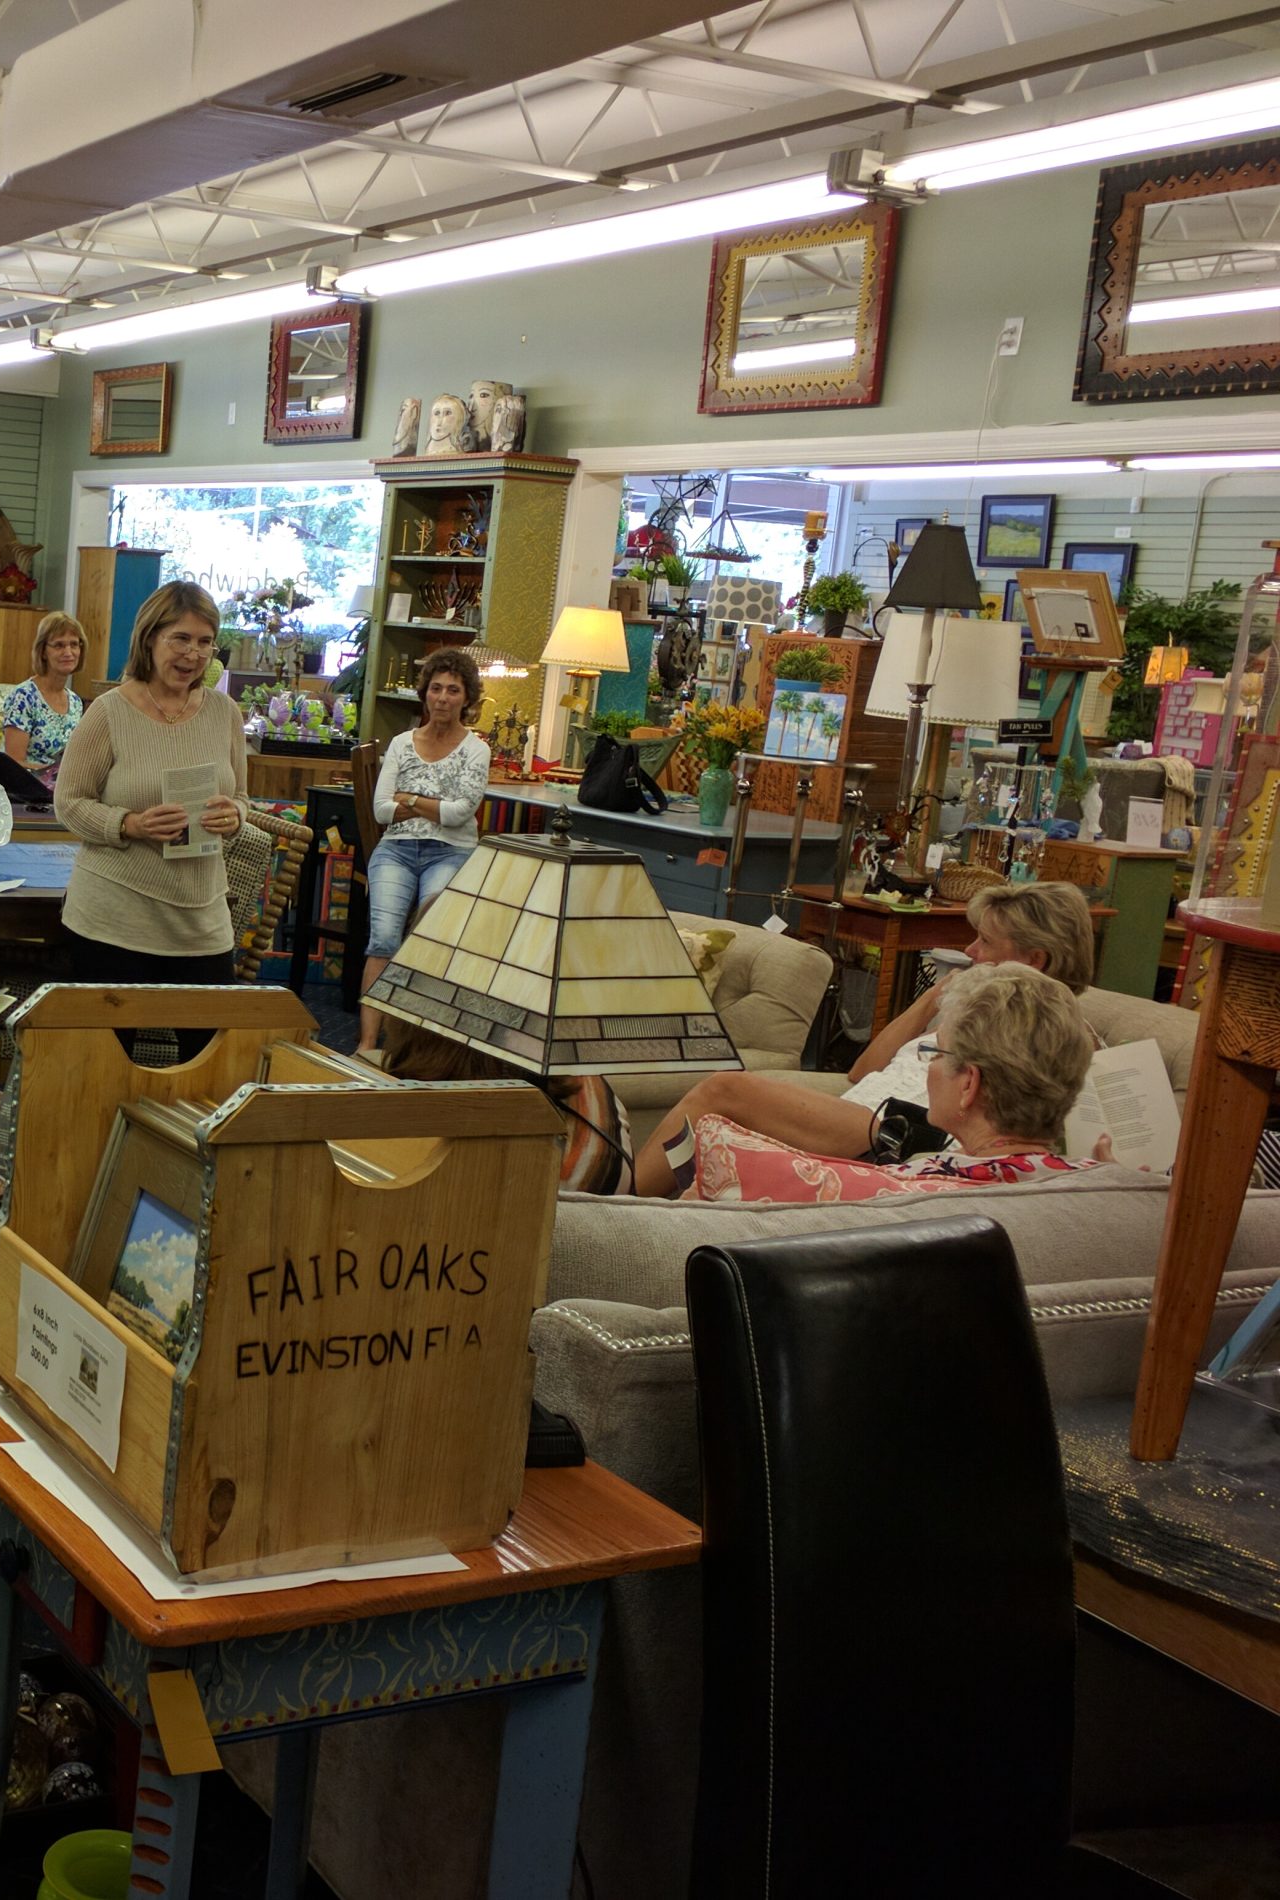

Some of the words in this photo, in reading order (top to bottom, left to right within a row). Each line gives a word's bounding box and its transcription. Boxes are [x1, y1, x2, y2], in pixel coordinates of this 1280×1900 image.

[247, 1248, 359, 1316] FAIR
[380, 1243, 489, 1296] OAKS
[33, 1304, 44, 1320] 6x8
[32, 1324, 58, 1355] Paintings
[236, 1328, 414, 1379] EVINSTON
[30, 1345, 50, 1370] 300.00
